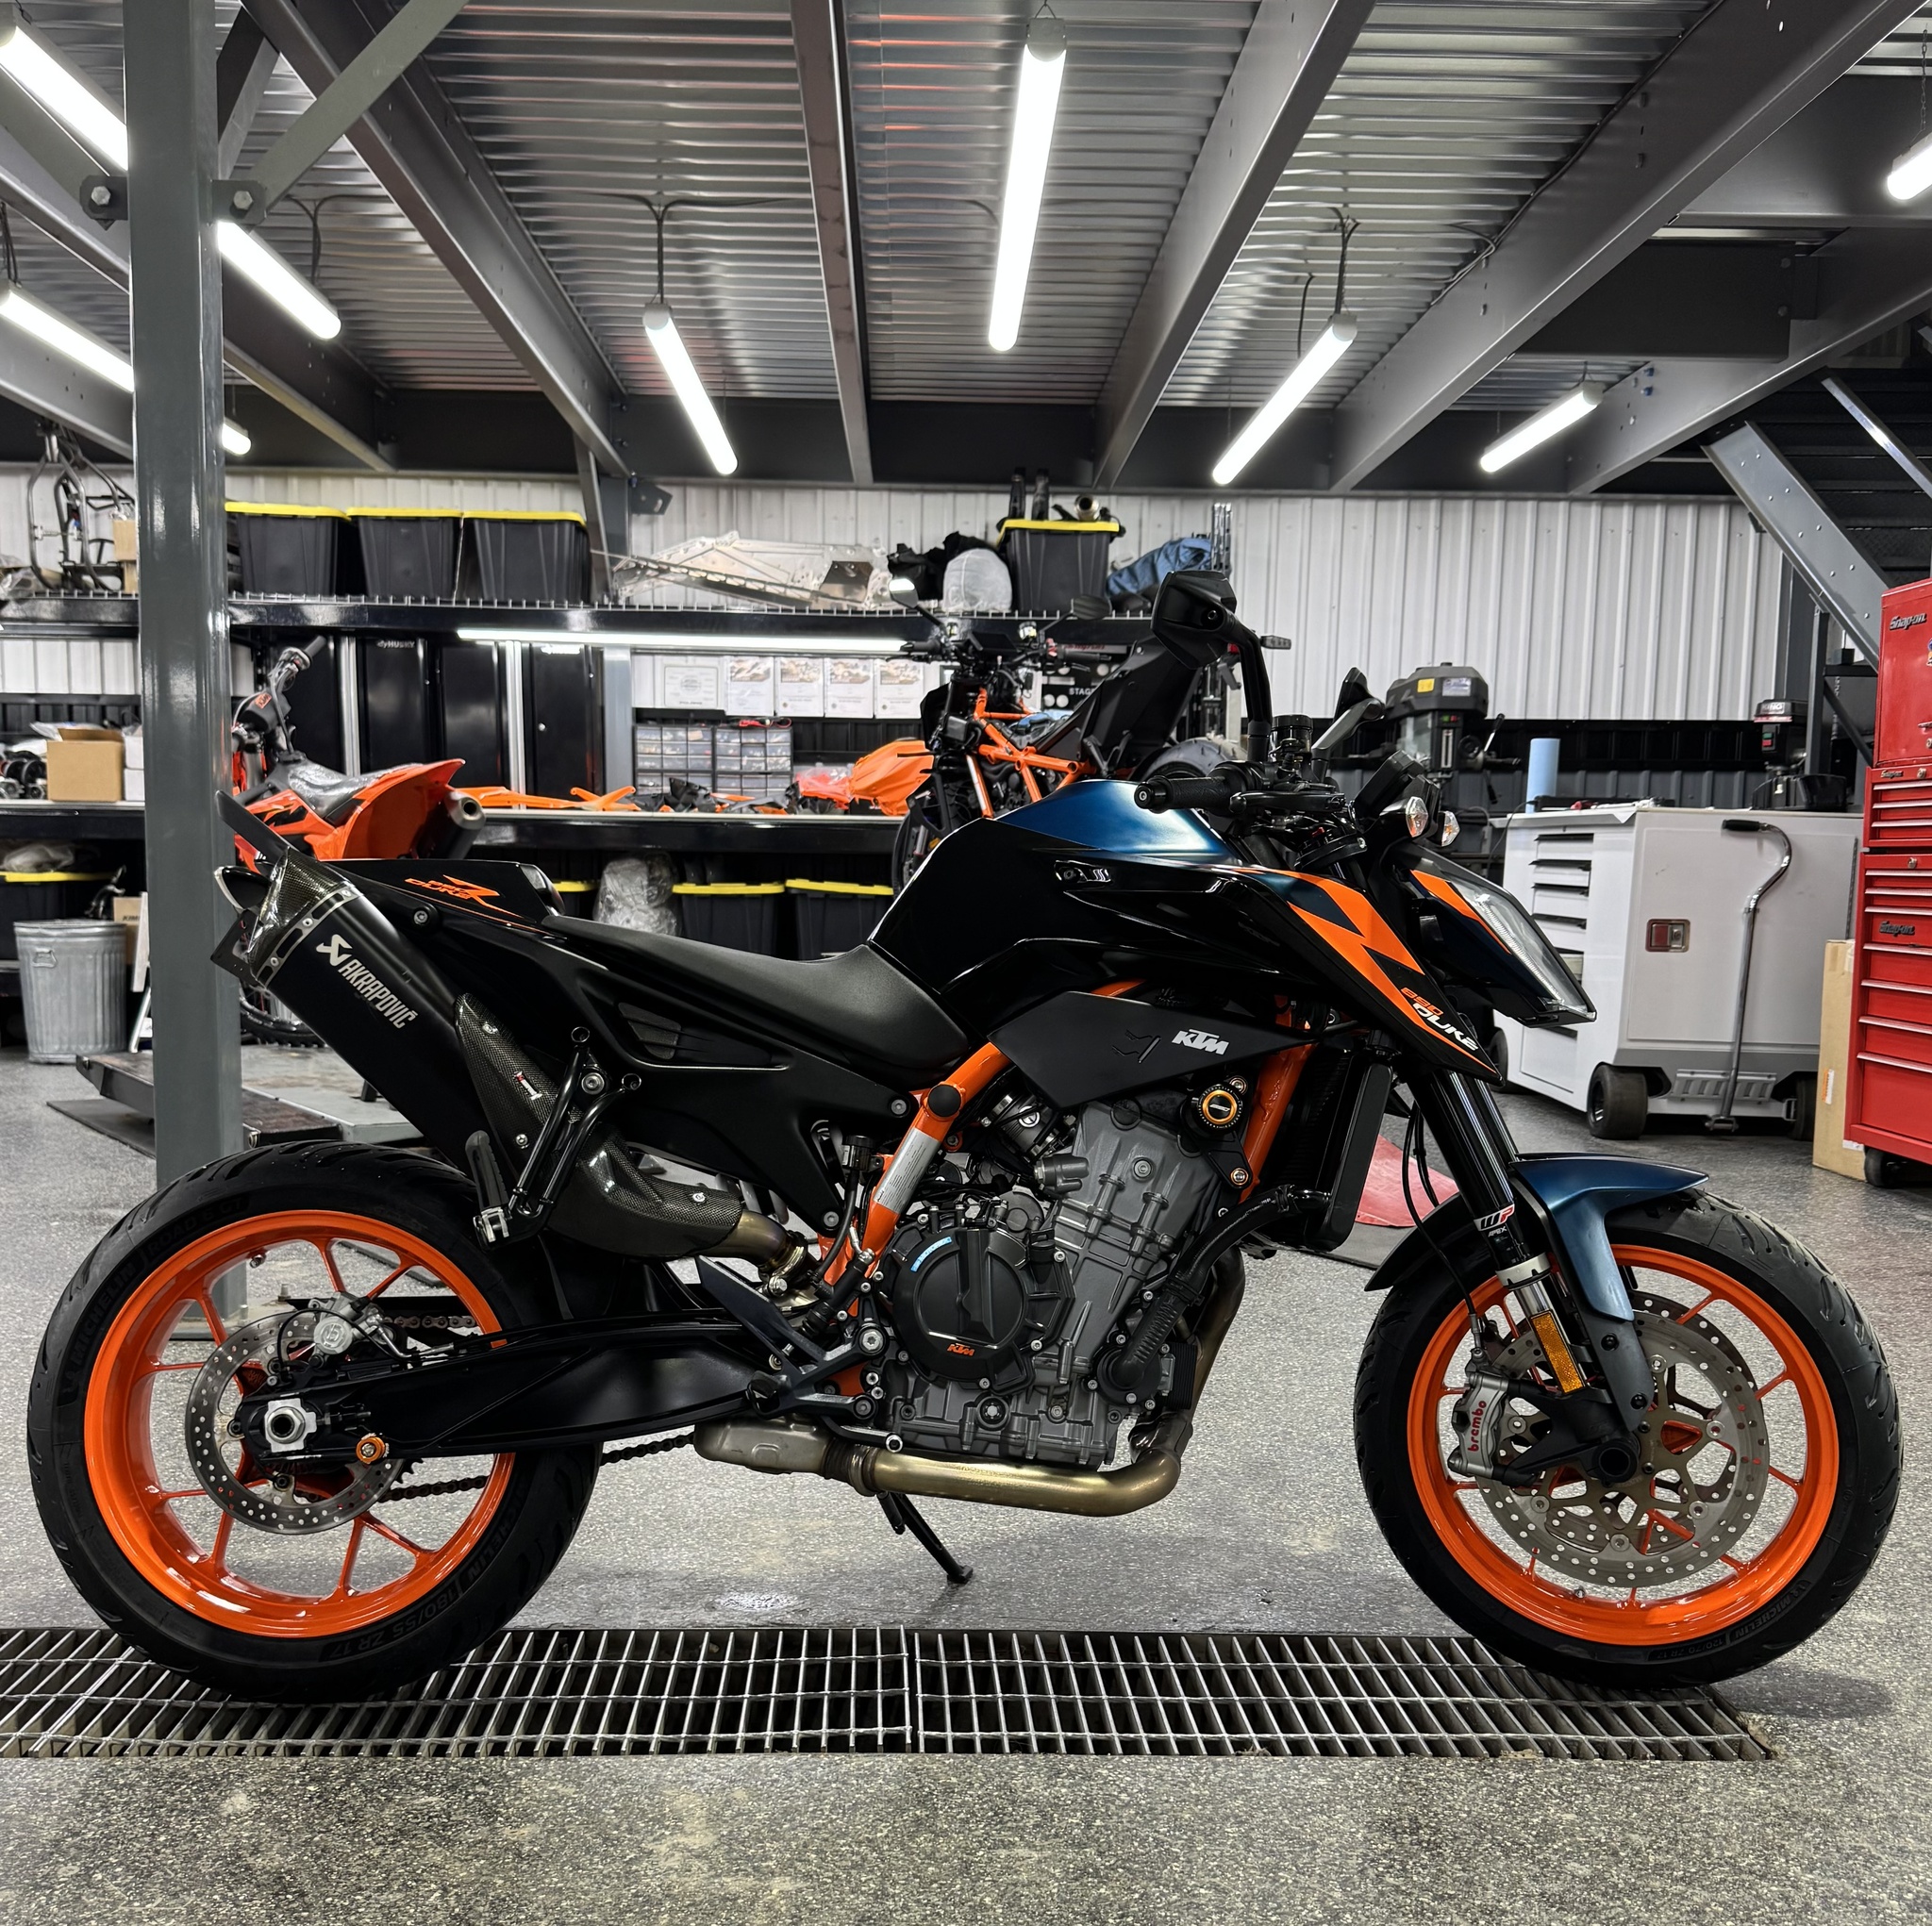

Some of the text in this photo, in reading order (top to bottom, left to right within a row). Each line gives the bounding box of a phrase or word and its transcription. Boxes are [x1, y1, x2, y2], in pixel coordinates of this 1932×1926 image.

[1890, 613, 1927, 631] Snap-on
[1413, 1003, 1478, 1051] DUKE
[1172, 1029, 1229, 1055] KTM
[1488, 1226, 1507, 1237] APEX
[946, 1343, 975, 1356] KTM
[1468, 1401, 1487, 1452] brembo
[1734, 1595, 1792, 1639] MICHELIN
